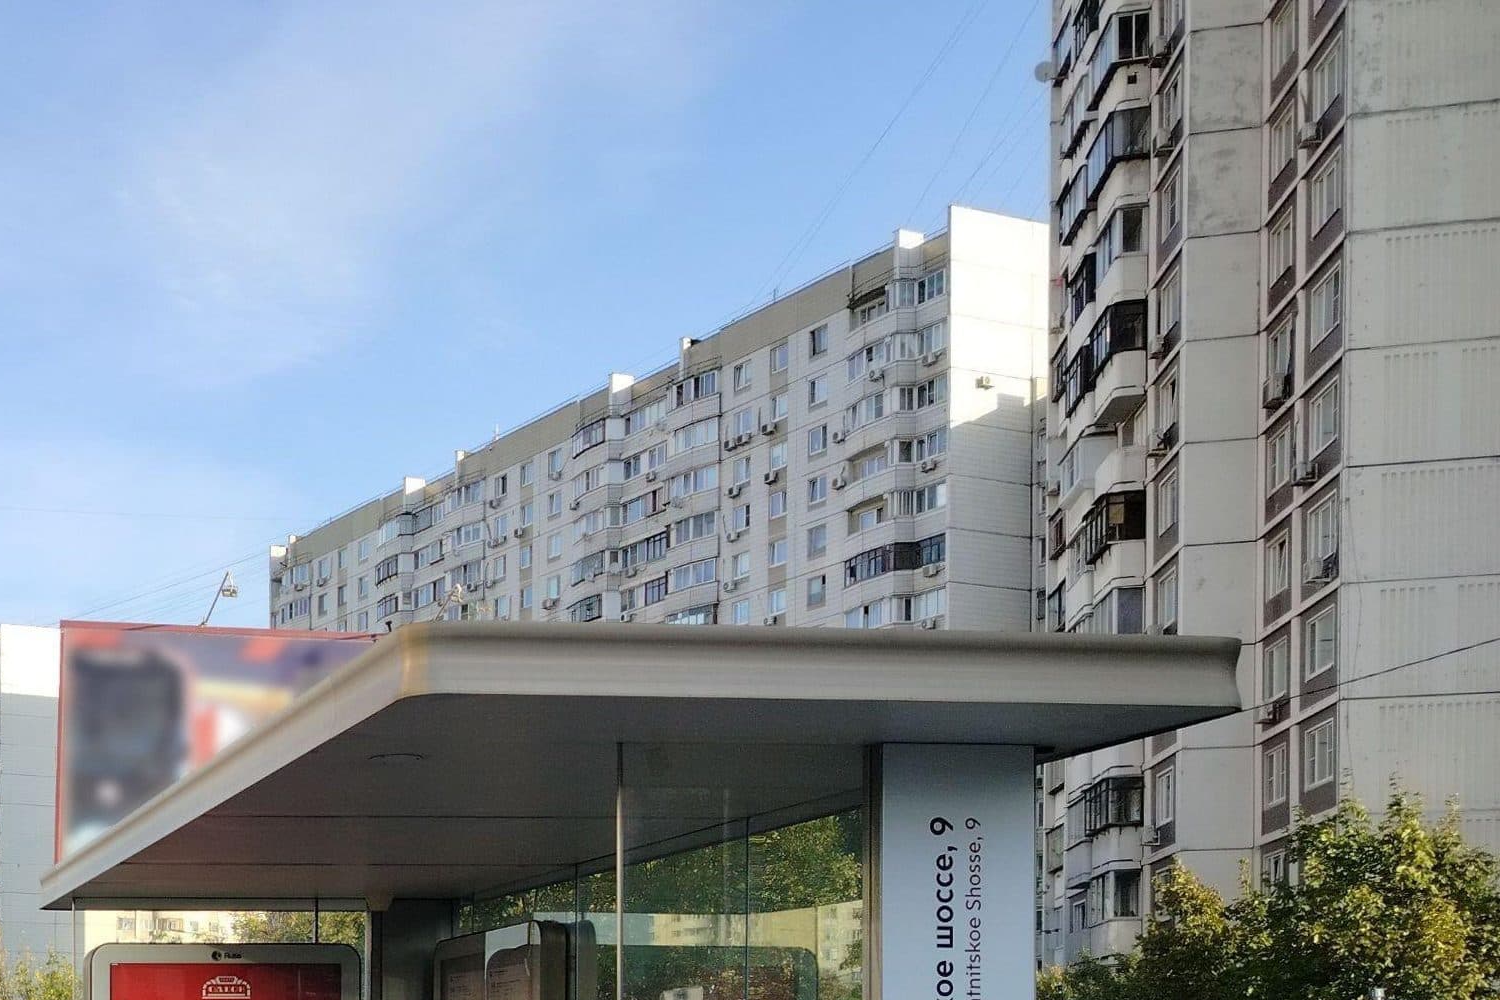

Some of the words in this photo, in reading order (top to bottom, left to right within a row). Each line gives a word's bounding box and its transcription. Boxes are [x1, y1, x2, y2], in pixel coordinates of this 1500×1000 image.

[929, 816, 955, 837] 9
[965, 816, 982, 830] 9
[965, 836, 983, 911] Shosse,
[936, 846, 958, 950] шоссе,
